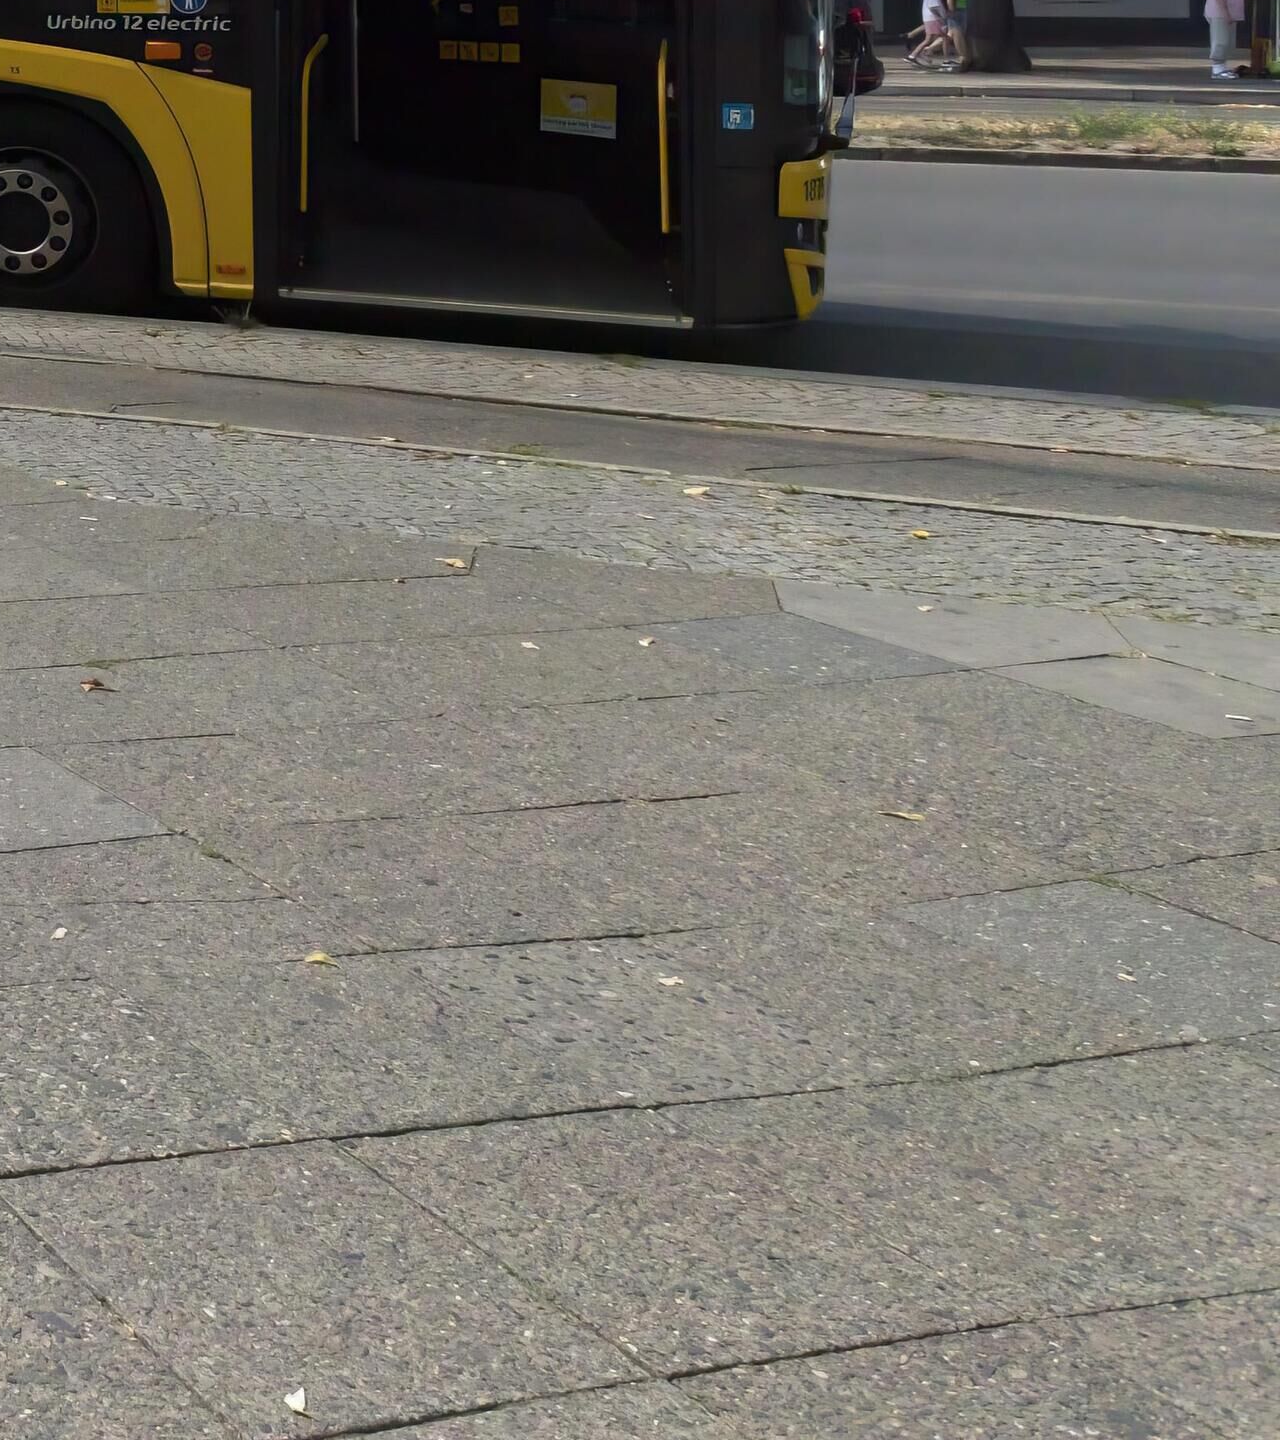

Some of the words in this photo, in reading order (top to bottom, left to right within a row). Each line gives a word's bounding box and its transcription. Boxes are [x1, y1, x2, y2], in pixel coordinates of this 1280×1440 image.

[47, 14, 117, 31] Urbino
[123, 15, 144, 31] 12
[146, 16, 233, 32] electric
